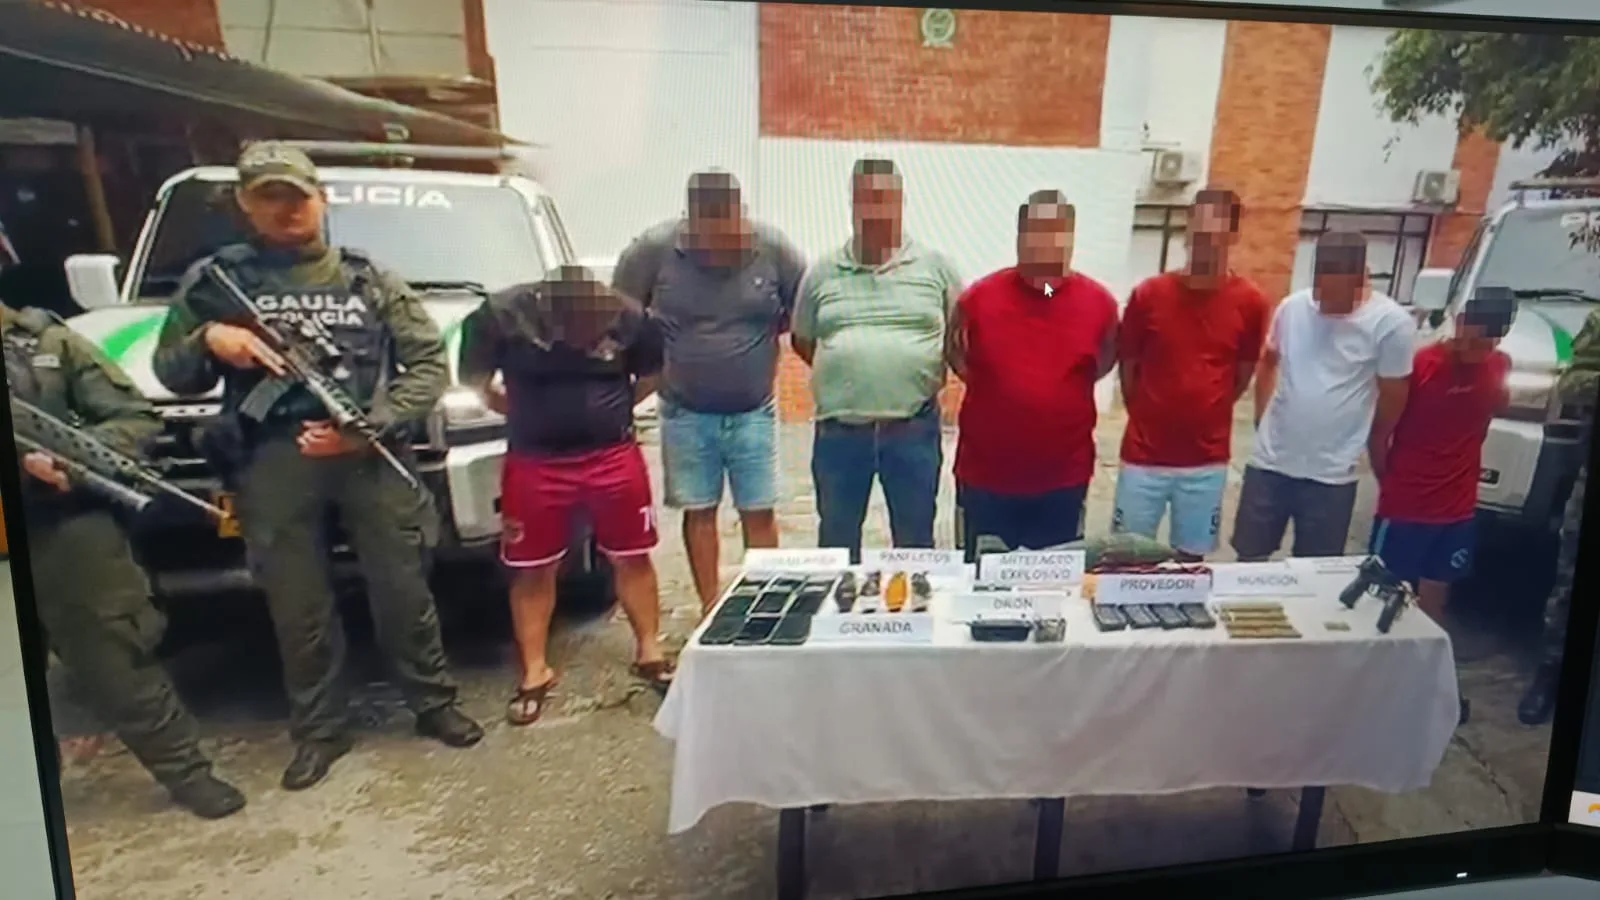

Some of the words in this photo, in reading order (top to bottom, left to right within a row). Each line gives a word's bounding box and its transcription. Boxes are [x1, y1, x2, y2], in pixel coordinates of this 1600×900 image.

[324, 184, 452, 210] LICÍA
[255, 294, 368, 312] GAULA
[1001, 568, 1071, 580] EXPLOSIVO
[1120, 579, 1195, 591] PROVEDOR
[839, 621, 913, 634] GRANADA
